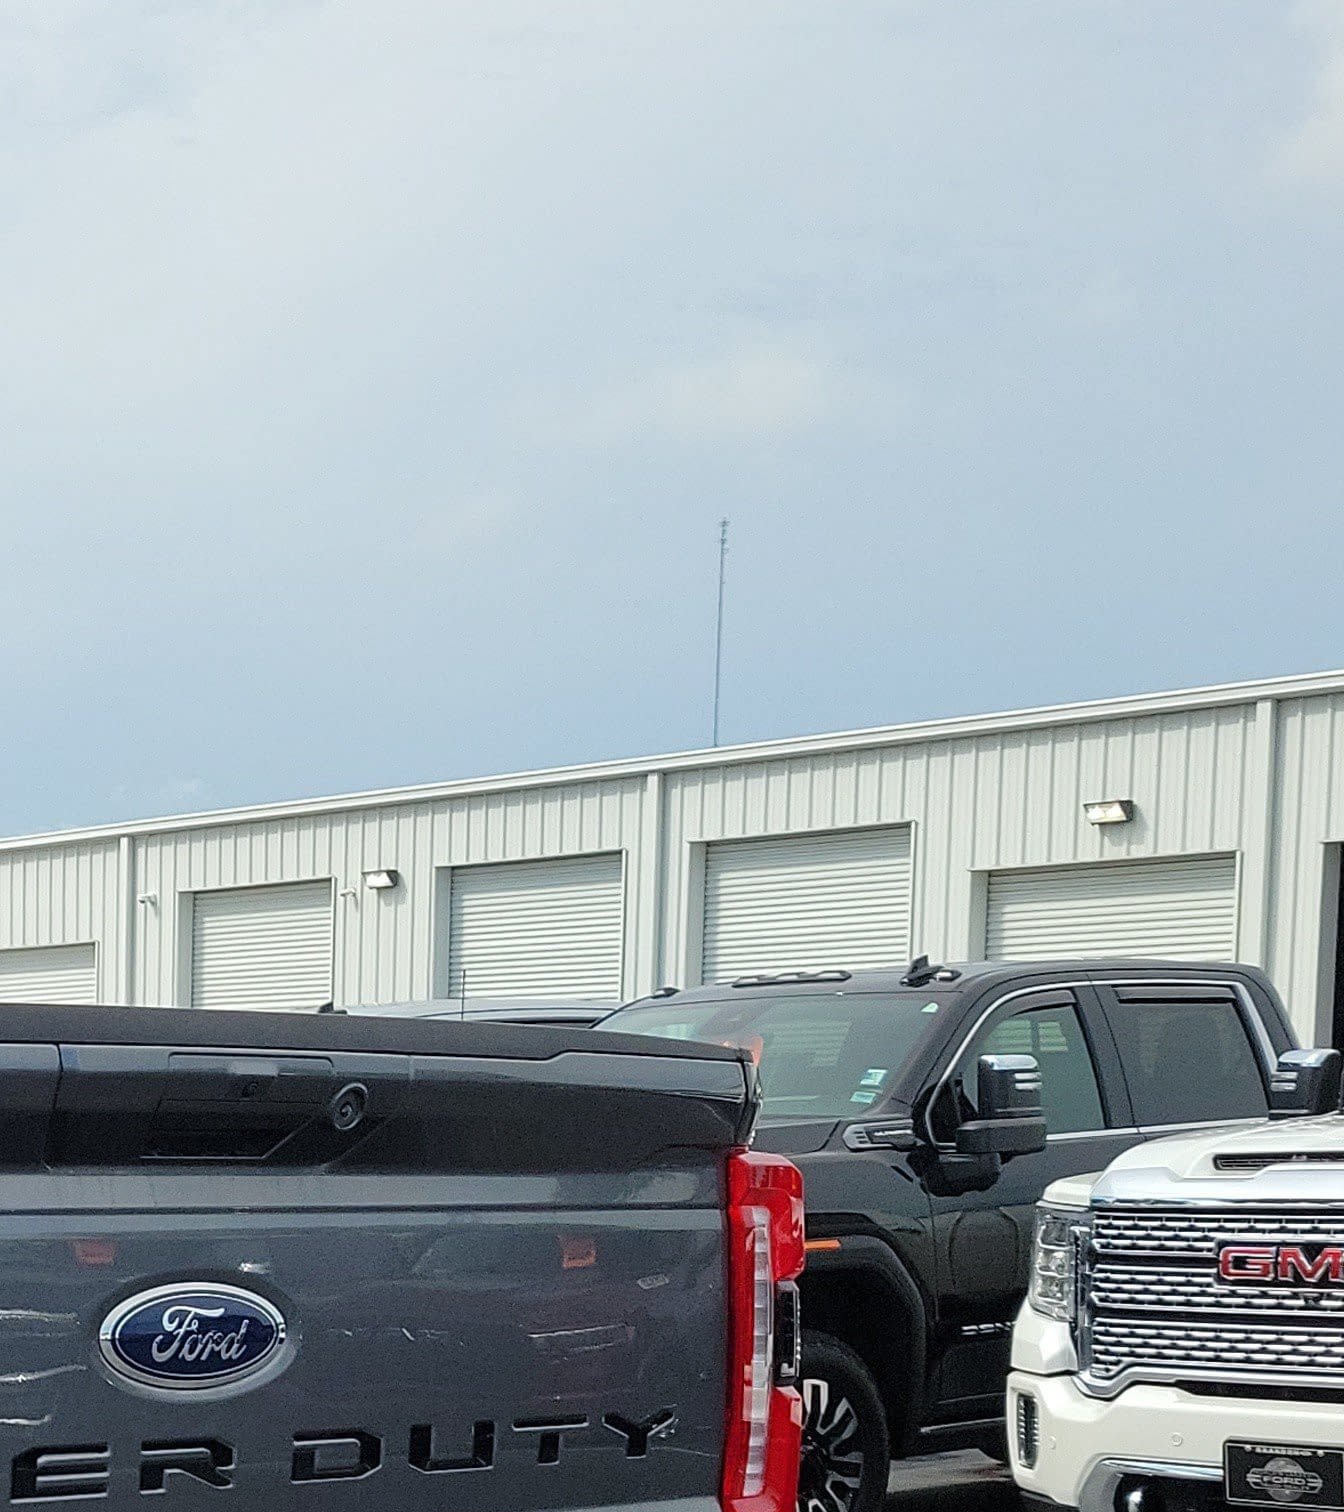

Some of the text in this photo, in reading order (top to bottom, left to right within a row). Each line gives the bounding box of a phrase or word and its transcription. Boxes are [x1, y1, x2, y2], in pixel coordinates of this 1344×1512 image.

[1219, 1246, 1344, 1282] GM
[151, 1305, 249, 1362] Ford
[291, 1404, 677, 1484] DUTY
